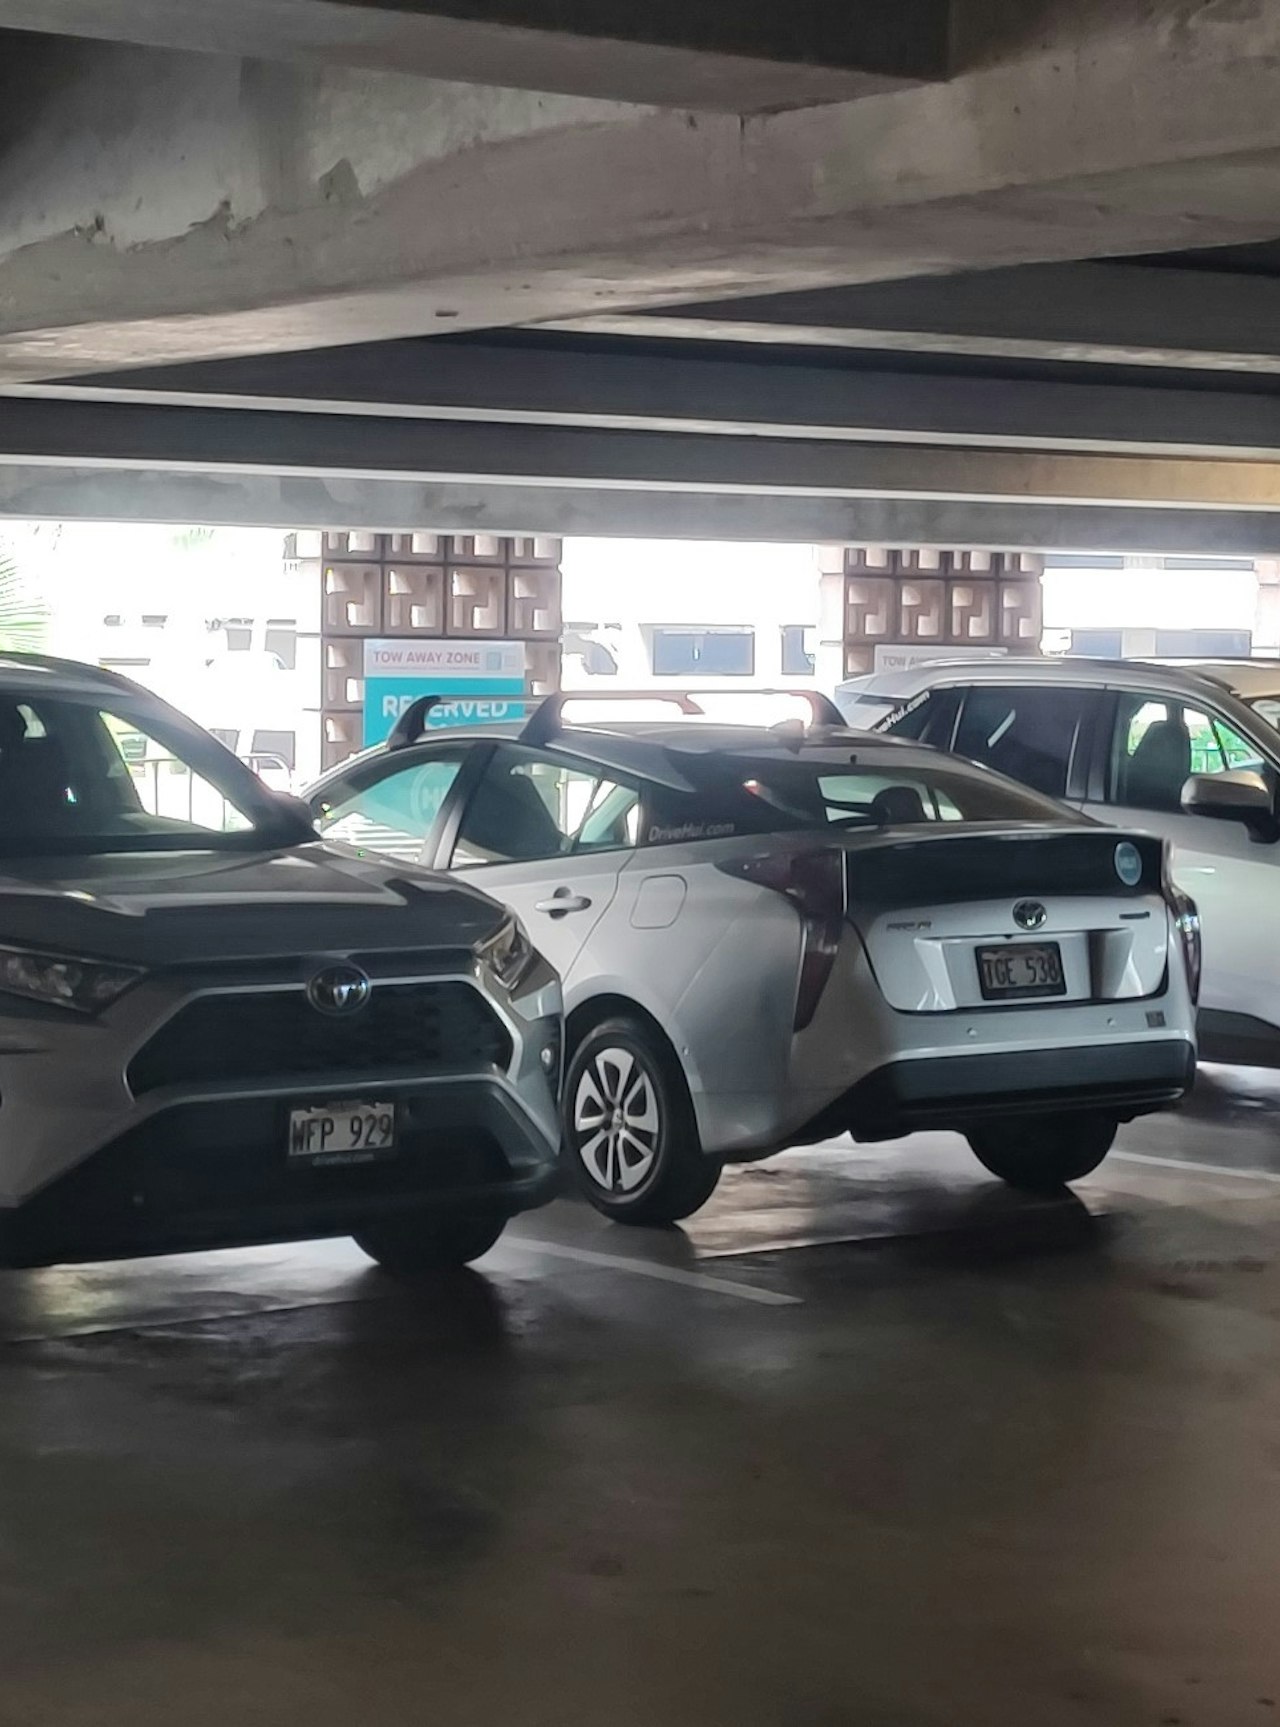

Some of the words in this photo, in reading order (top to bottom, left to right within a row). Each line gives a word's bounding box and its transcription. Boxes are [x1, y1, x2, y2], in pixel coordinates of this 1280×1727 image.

[373, 651, 403, 663] TOW
[406, 651, 443, 664] AWAY
[446, 652, 481, 664] ZONE
[382, 695, 508, 718] REERVED
[292, 1118, 334, 1152] WFP
[350, 1113, 392, 1148] 929
